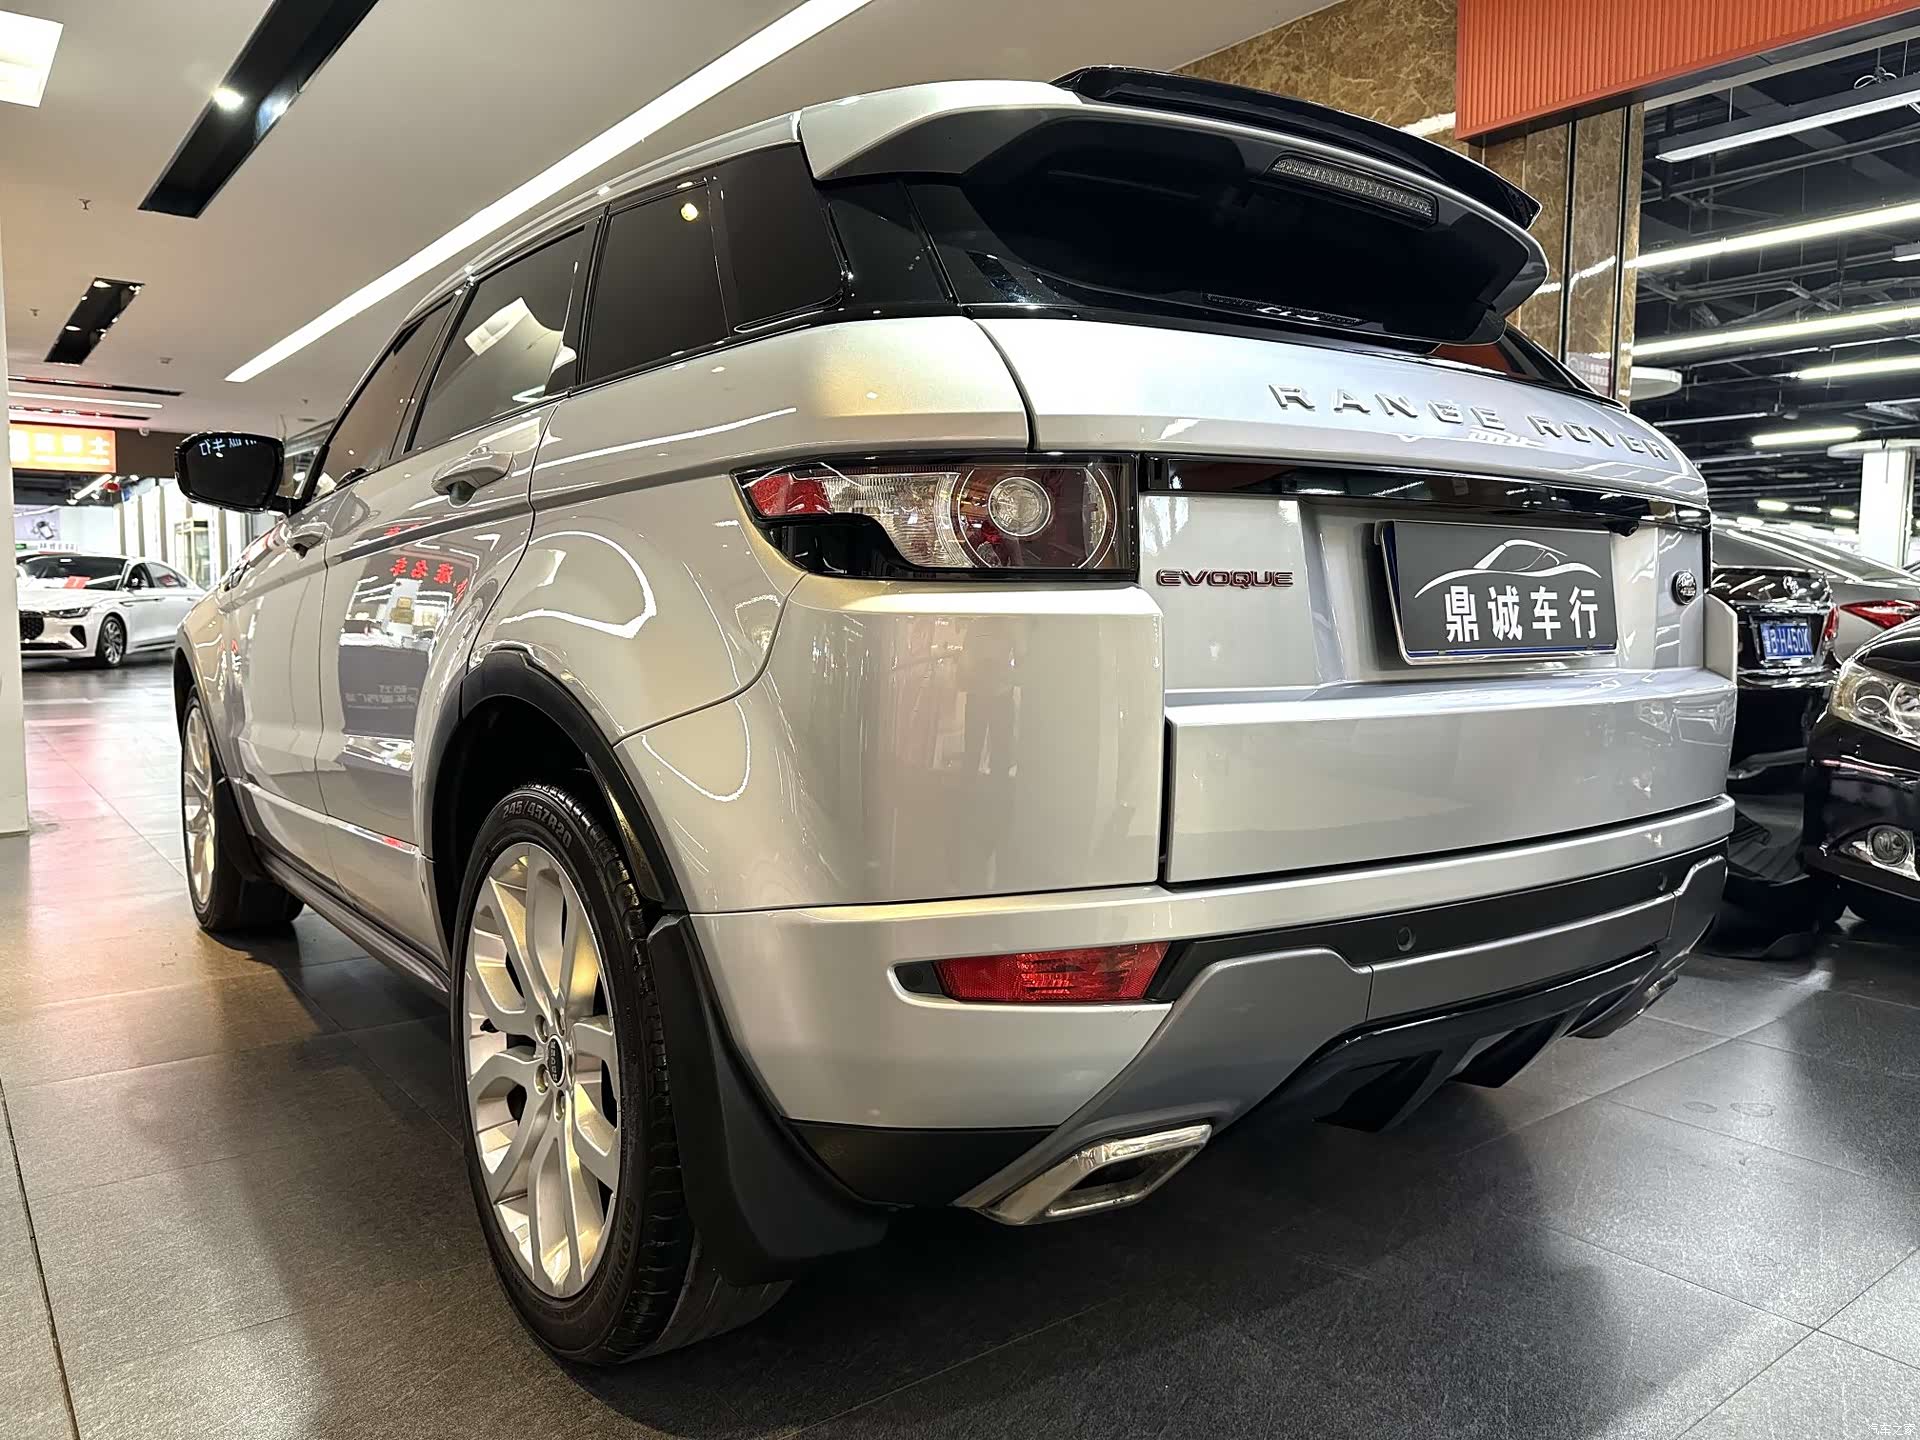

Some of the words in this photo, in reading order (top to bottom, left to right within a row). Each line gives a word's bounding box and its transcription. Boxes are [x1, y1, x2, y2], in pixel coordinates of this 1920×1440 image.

[1268, 383, 1506, 430] RANGE
[1526, 415, 1669, 461] ROVER
[1156, 568, 1294, 588] EVOQUE
[1444, 585, 1600, 643] 鼎诚车行
